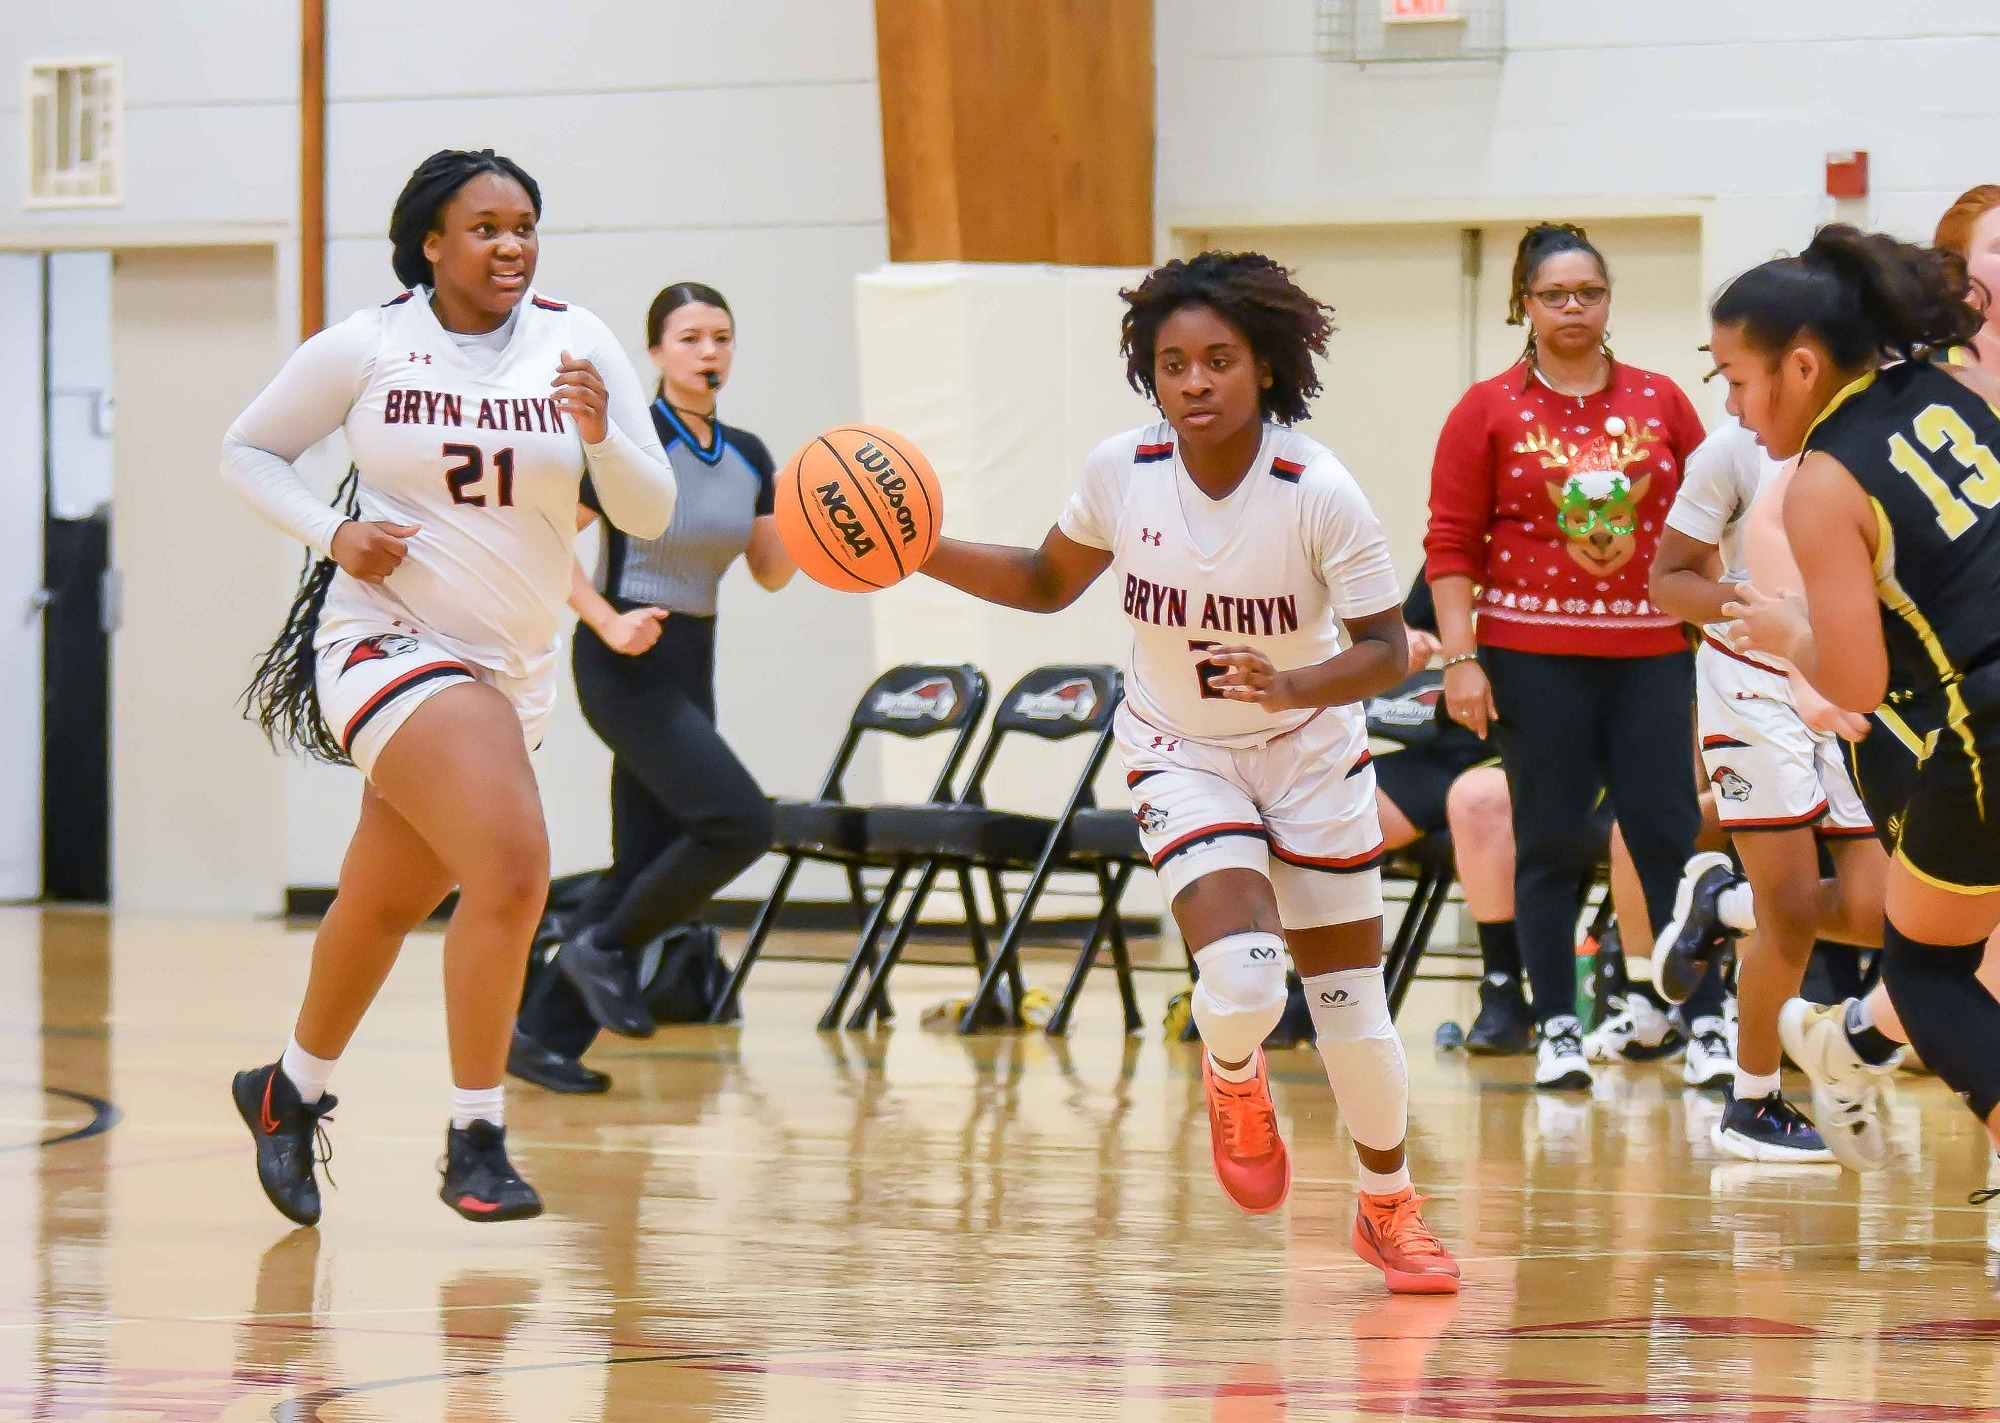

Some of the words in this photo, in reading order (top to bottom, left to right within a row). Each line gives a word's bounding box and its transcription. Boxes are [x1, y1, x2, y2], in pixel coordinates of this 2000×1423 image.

[384, 389, 462, 427] BRYN
[477, 397, 565, 434] ATHYN
[442, 442, 514, 507] 21
[854, 442, 917, 546] Wilson
[1887, 403, 2000, 541] 13
[816, 481, 877, 559] NCAA
[1123, 572, 1187, 627] BRYN
[1201, 592, 1298, 636] ATHYN
